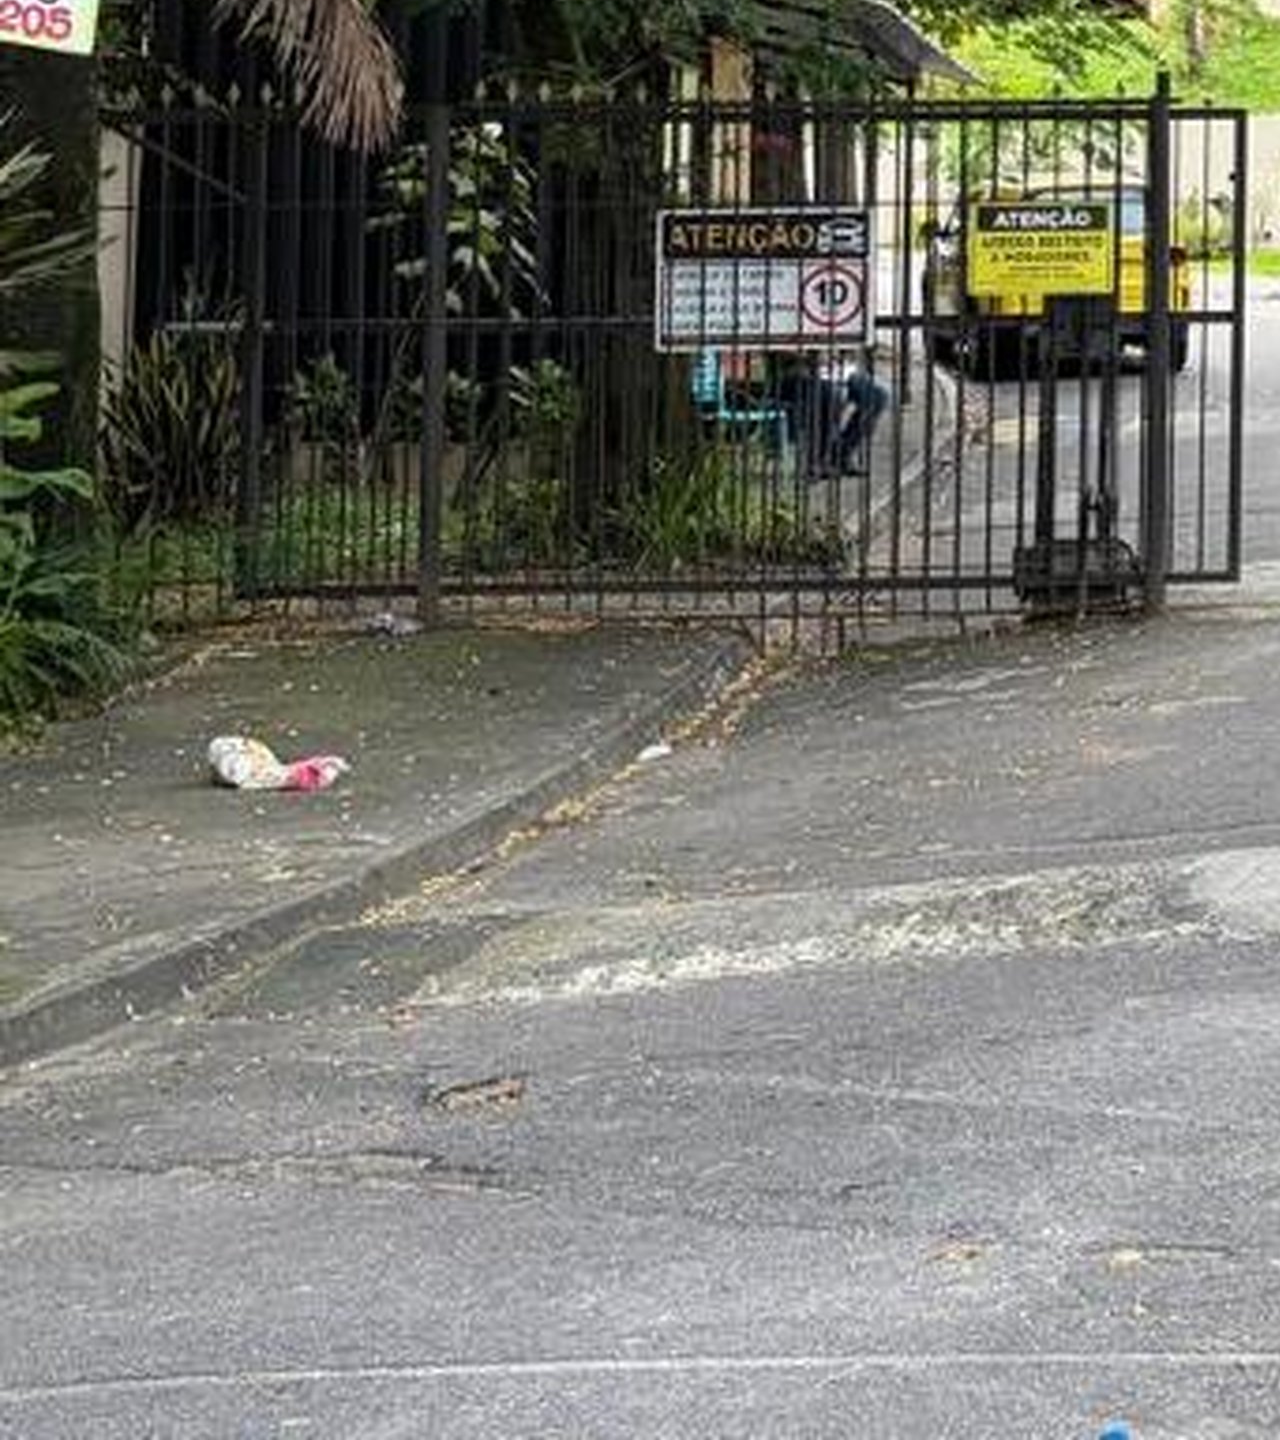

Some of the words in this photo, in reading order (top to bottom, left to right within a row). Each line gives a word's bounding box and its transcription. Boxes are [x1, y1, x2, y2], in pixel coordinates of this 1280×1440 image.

[992, 207, 1092, 228] ATENÇÃO
[668, 217, 815, 255] ATENÇÃO
[812, 279, 849, 307] 10
